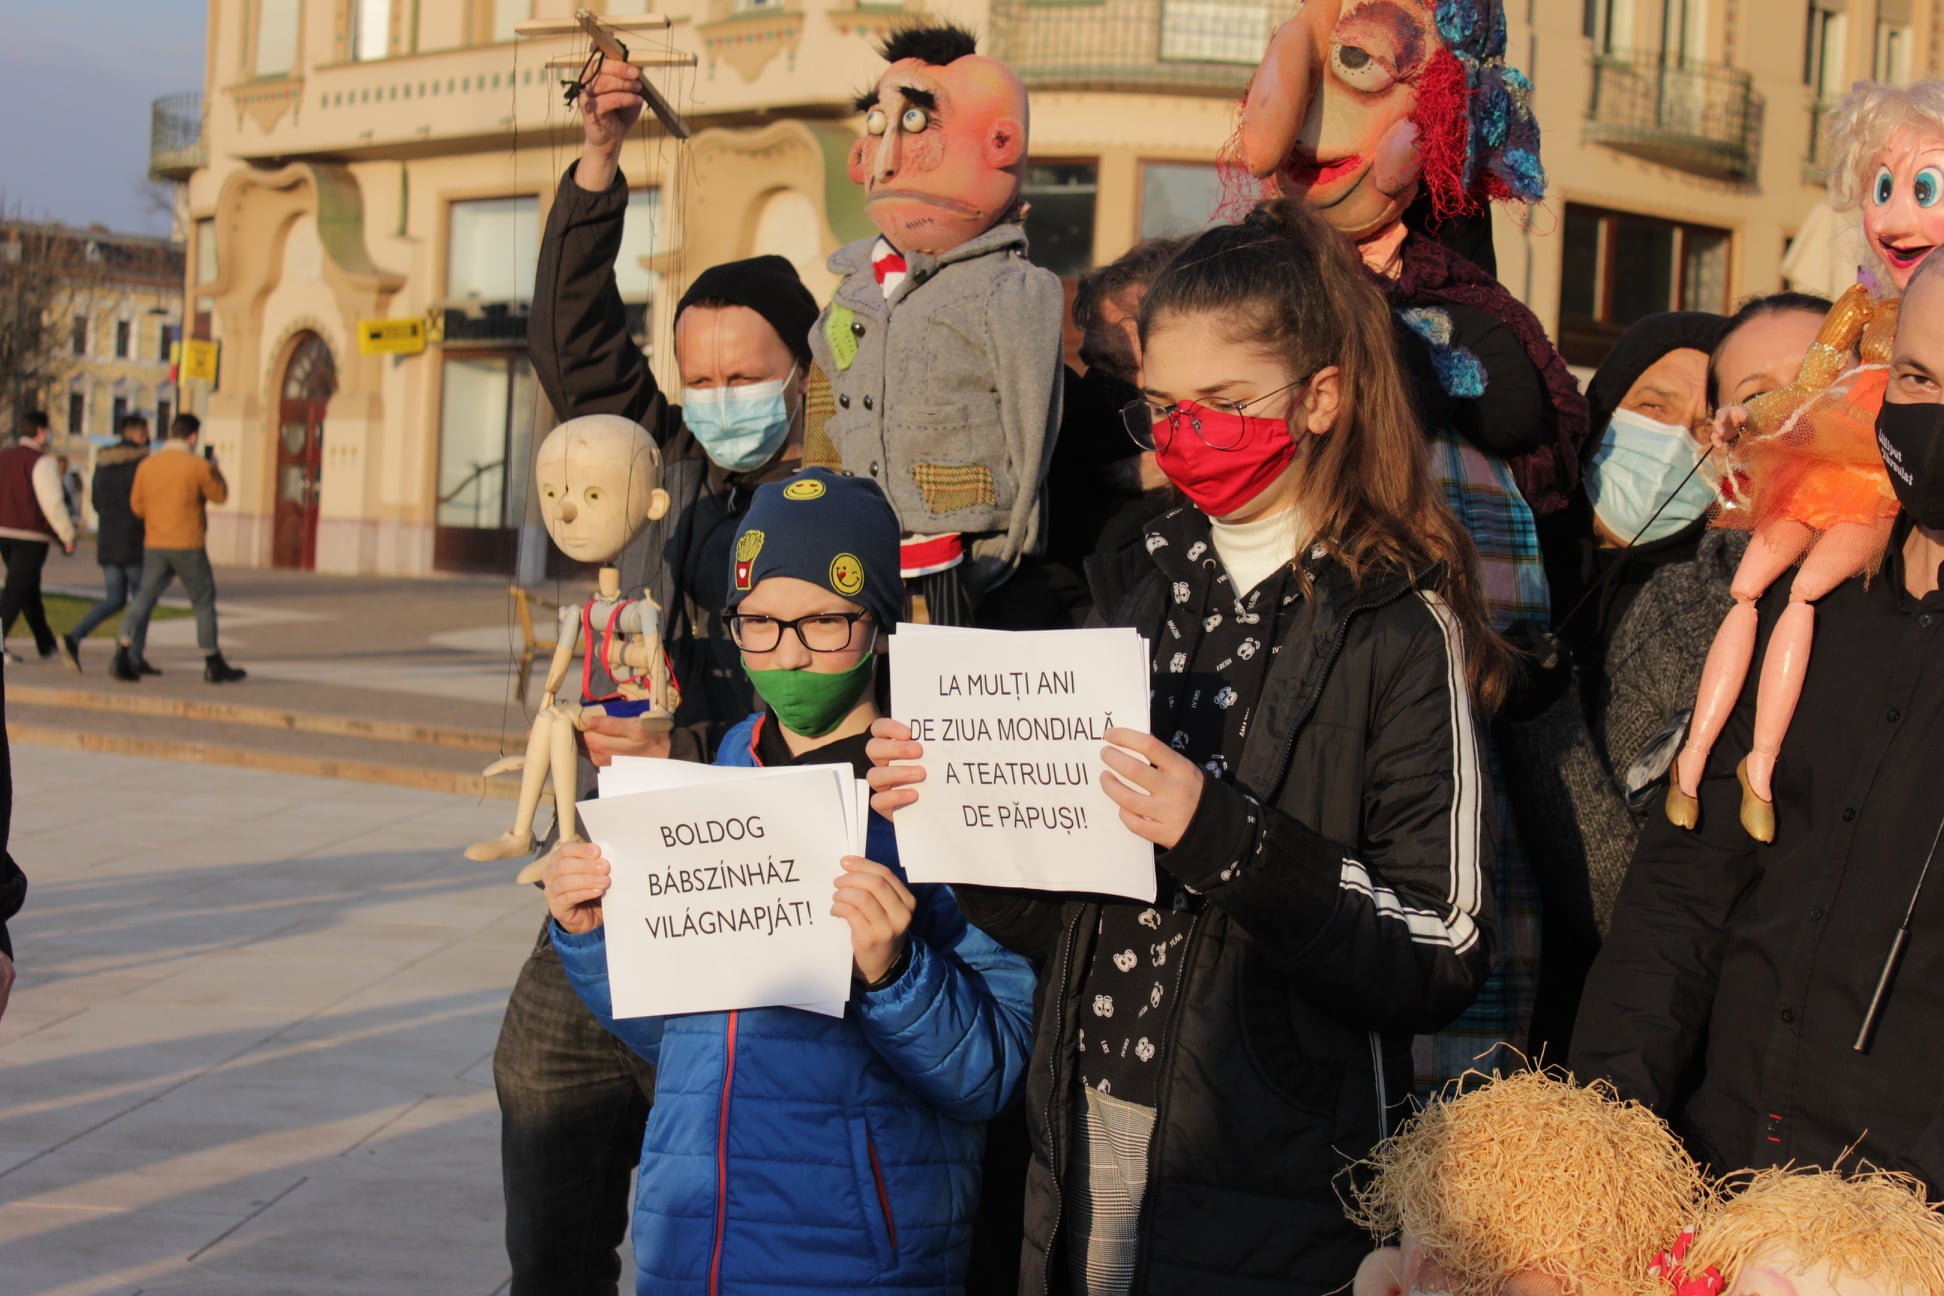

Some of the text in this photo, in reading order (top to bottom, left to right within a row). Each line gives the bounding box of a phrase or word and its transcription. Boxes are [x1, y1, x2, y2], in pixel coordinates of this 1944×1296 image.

[939, 670, 1076, 701] LA MULȚI ANI
[910, 711, 1115, 742] DE ZIUA MONDIALĂ
[946, 762, 1089, 786] A TEATRULUI
[660, 815, 765, 848] BOLDOG
[962, 801, 1089, 835] DE PĂPUȘI!
[648, 855, 800, 897] BÁBSZÍNHÁZ
[645, 897, 814, 940] VILÁGNAPJÁT!
